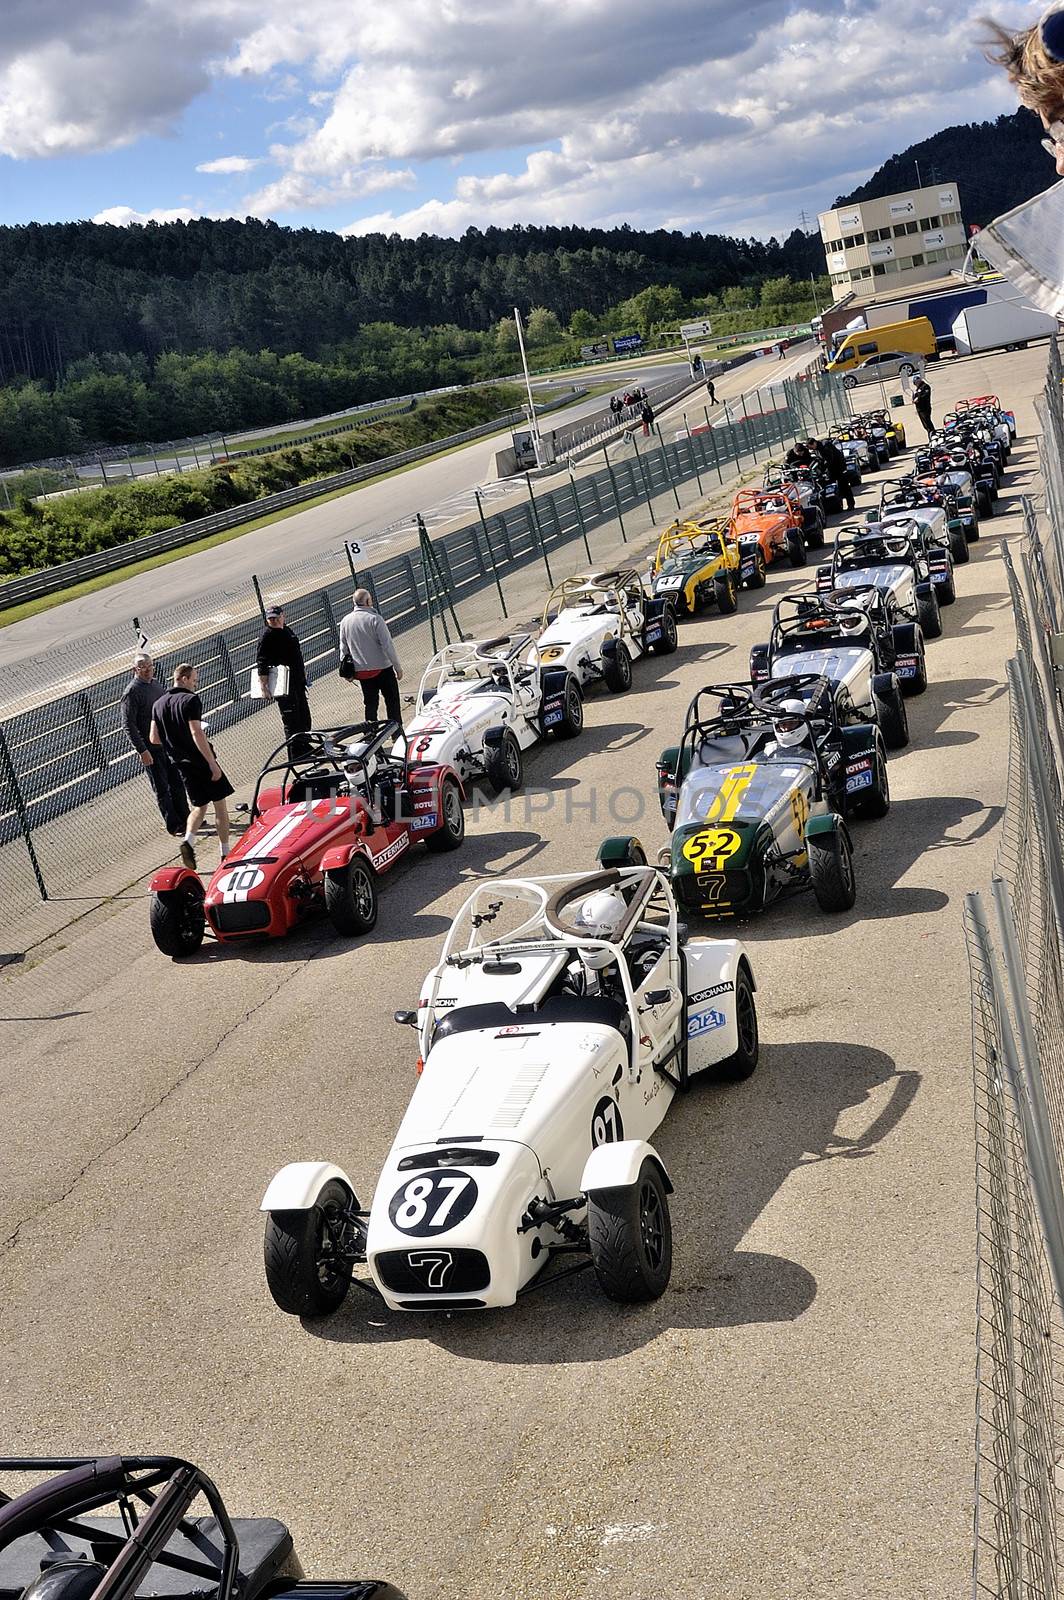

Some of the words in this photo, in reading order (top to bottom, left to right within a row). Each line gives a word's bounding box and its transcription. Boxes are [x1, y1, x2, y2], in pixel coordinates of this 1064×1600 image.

[350, 542, 361, 554] 8
[739, 534, 757, 542] 92
[660, 576, 679, 586] 47
[539, 648, 561, 659] 75
[689, 833, 734, 859] 52
[227, 870, 259, 892] 10
[697, 874, 727, 900] 7
[691, 983, 733, 1003] YOKOHAMA
[395, 1176, 472, 1230] 87
[407, 1250, 453, 1288] 7
